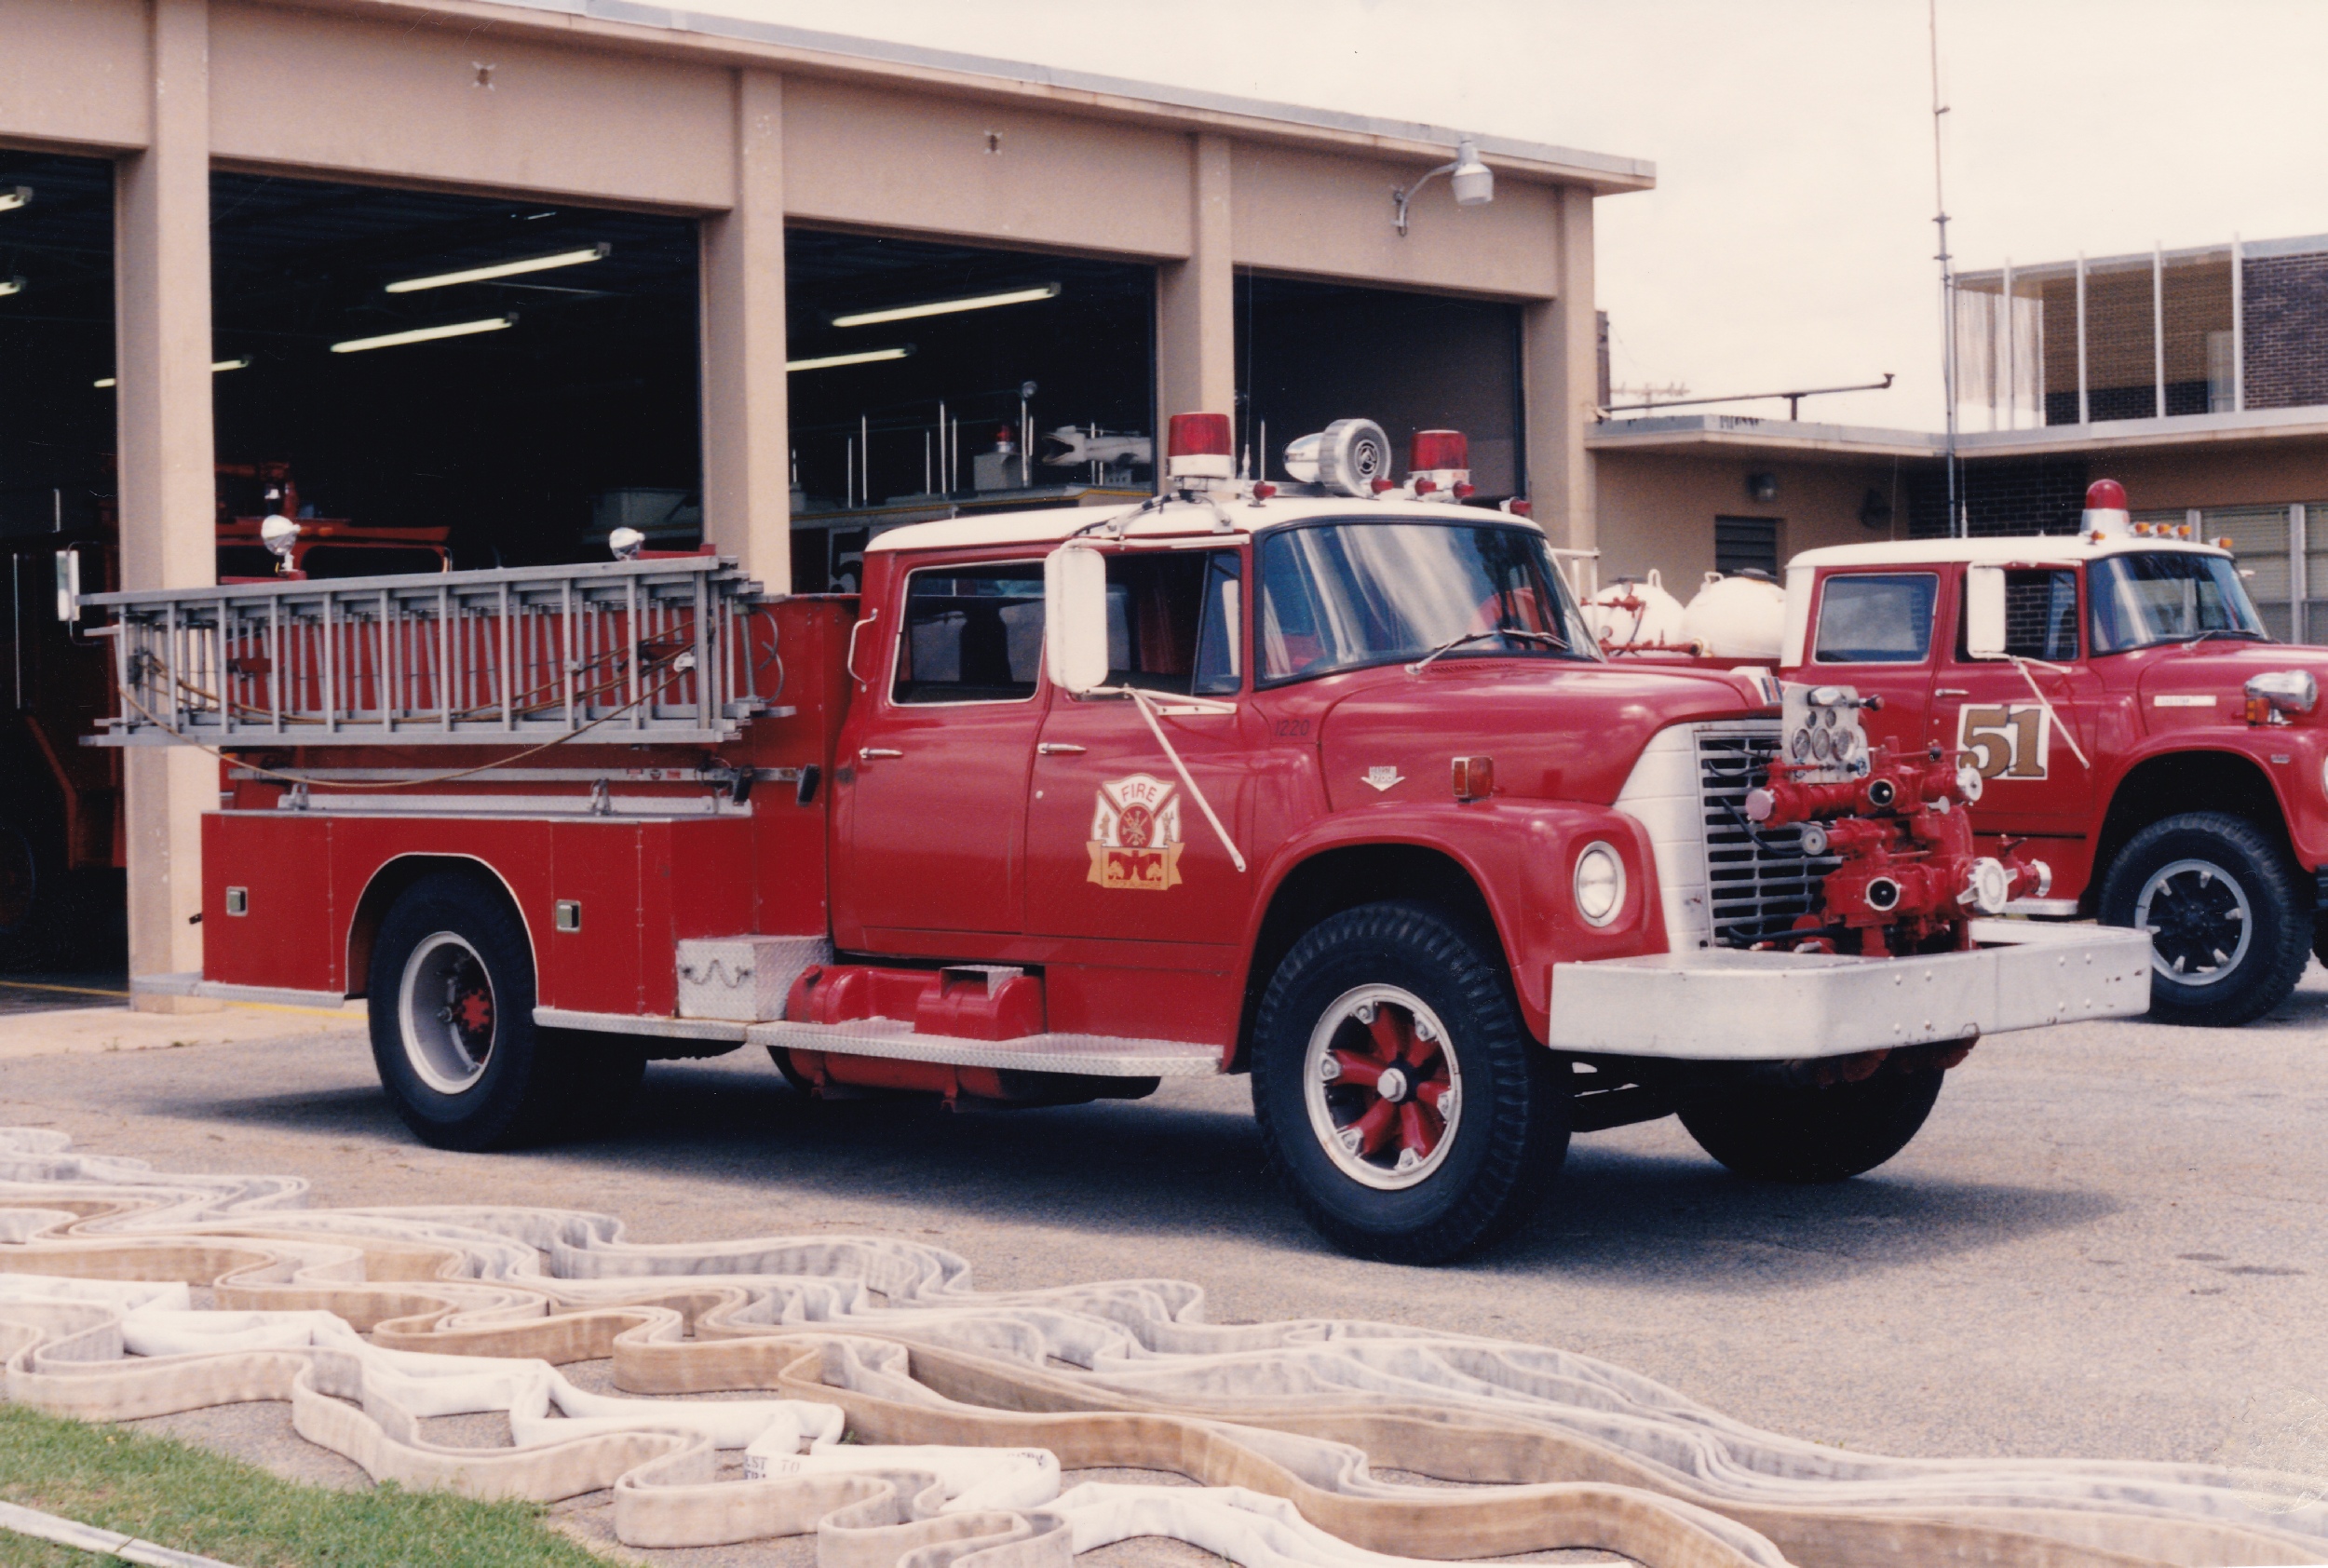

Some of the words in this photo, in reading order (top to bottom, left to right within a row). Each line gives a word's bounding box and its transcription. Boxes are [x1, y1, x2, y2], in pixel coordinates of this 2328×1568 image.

[1275, 719, 1310, 737] 1220
[1959, 706, 2046, 778] 51
[1120, 782, 1157, 803] FIRE
